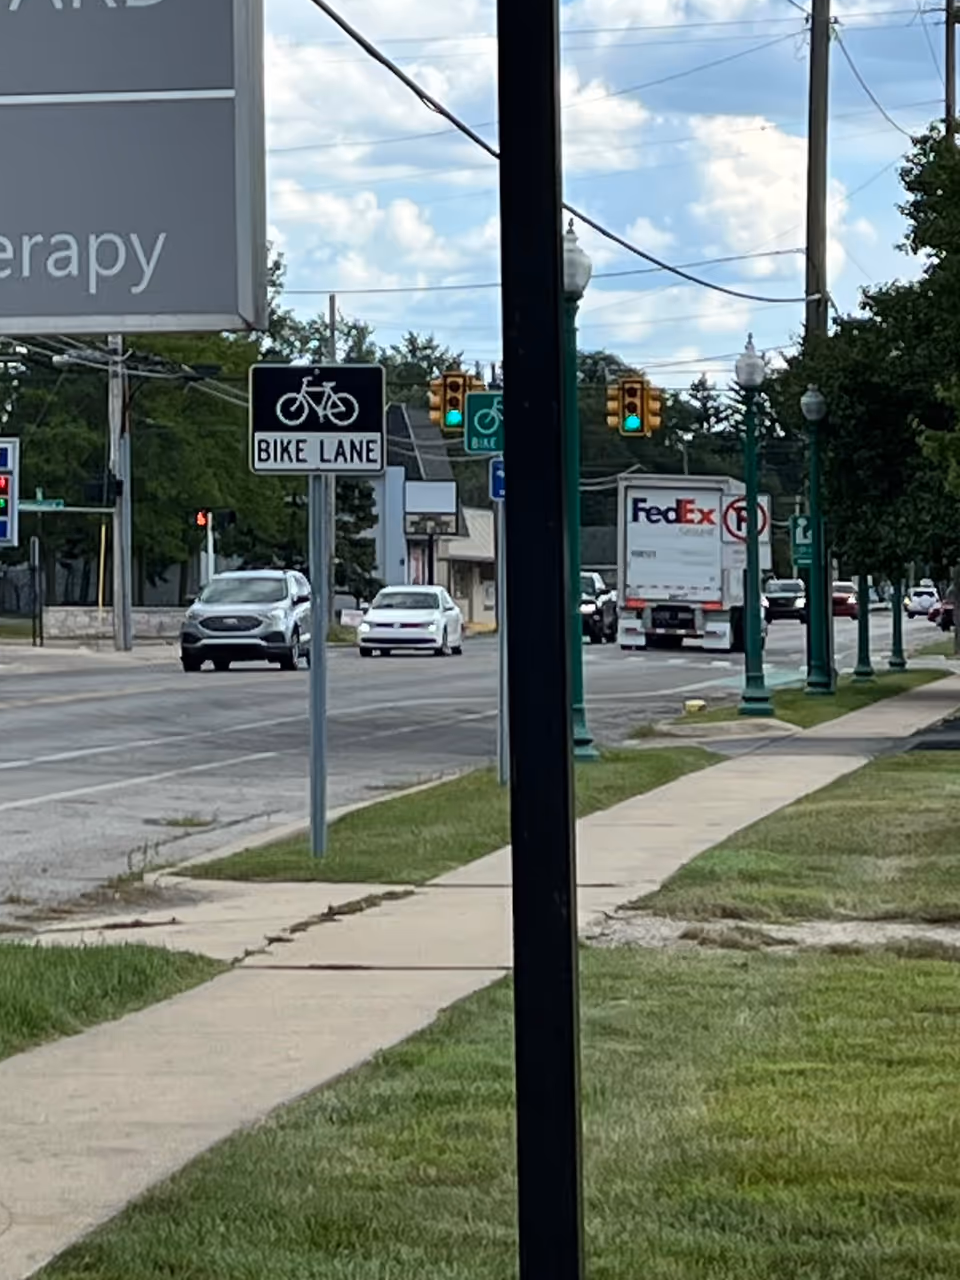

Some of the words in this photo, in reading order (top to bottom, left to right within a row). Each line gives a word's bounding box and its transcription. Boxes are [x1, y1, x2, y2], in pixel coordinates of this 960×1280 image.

[256, 438, 309, 464] BIKE
[319, 438, 379, 464] LANE
[471, 436, 498, 450] BIKE
[631, 497, 717, 526] FedEx
